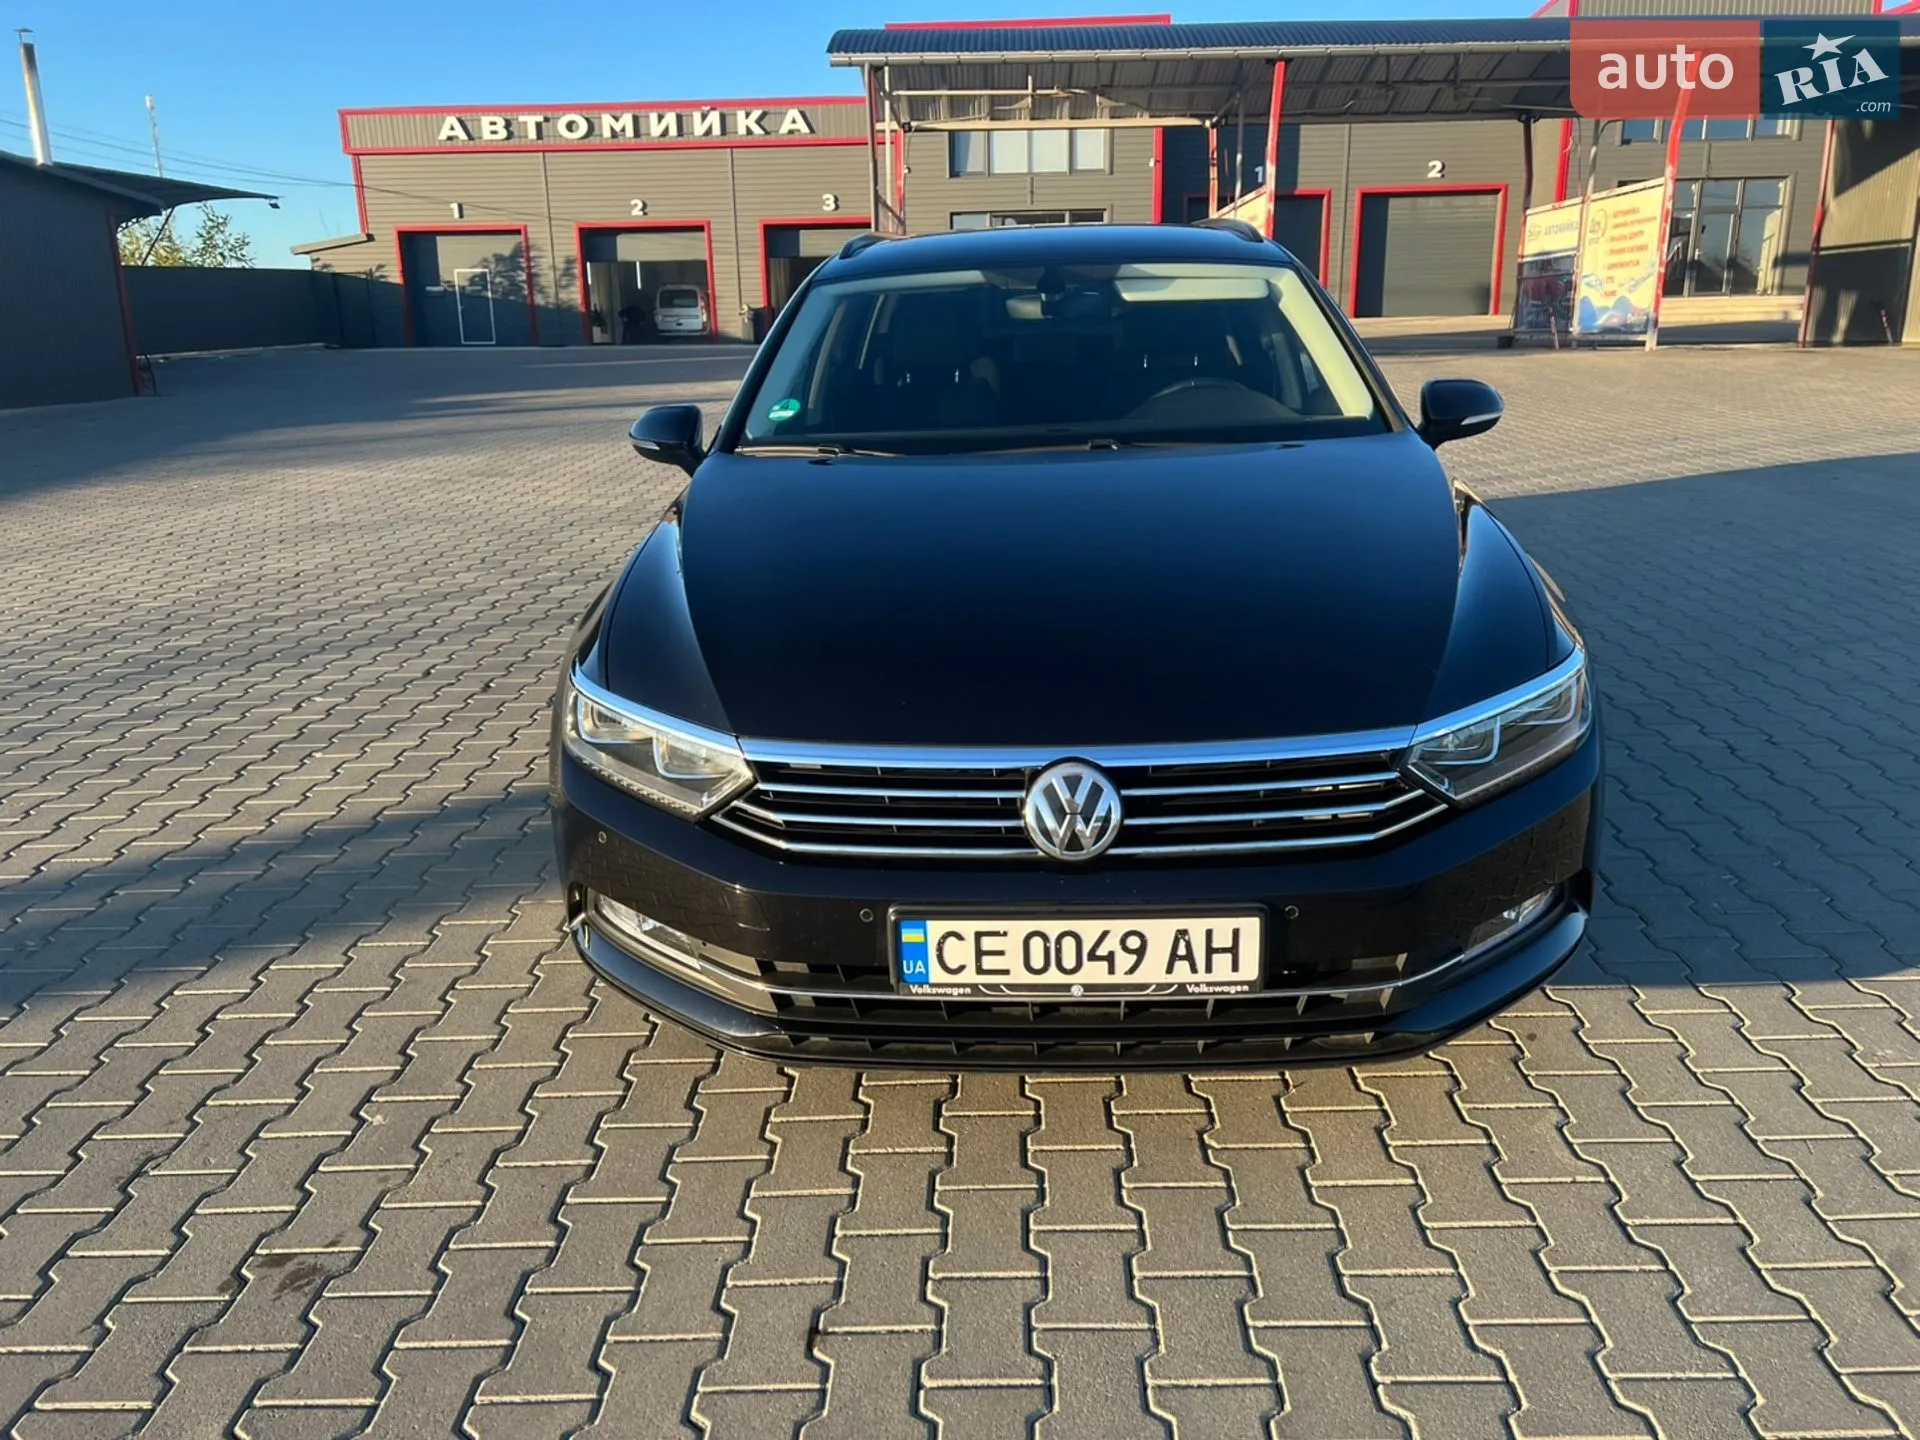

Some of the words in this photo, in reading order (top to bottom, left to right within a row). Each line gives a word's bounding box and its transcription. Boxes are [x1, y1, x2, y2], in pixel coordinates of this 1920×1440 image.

[438, 106, 813, 141] АВТОМИЙКА
[1254, 165, 1264, 183] 1
[1427, 160, 1445, 178] 2
[450, 202, 462, 219] 1
[630, 199, 647, 216] 2
[822, 193, 838, 211] 3
[935, 930, 1011, 976] CE
[1022, 929, 1148, 976] 0049
[1165, 928, 1240, 975] AH
[903, 960, 927, 975] UA
[909, 984, 972, 996] Volkswagen
[1186, 982, 1249, 994] Volkswagen
